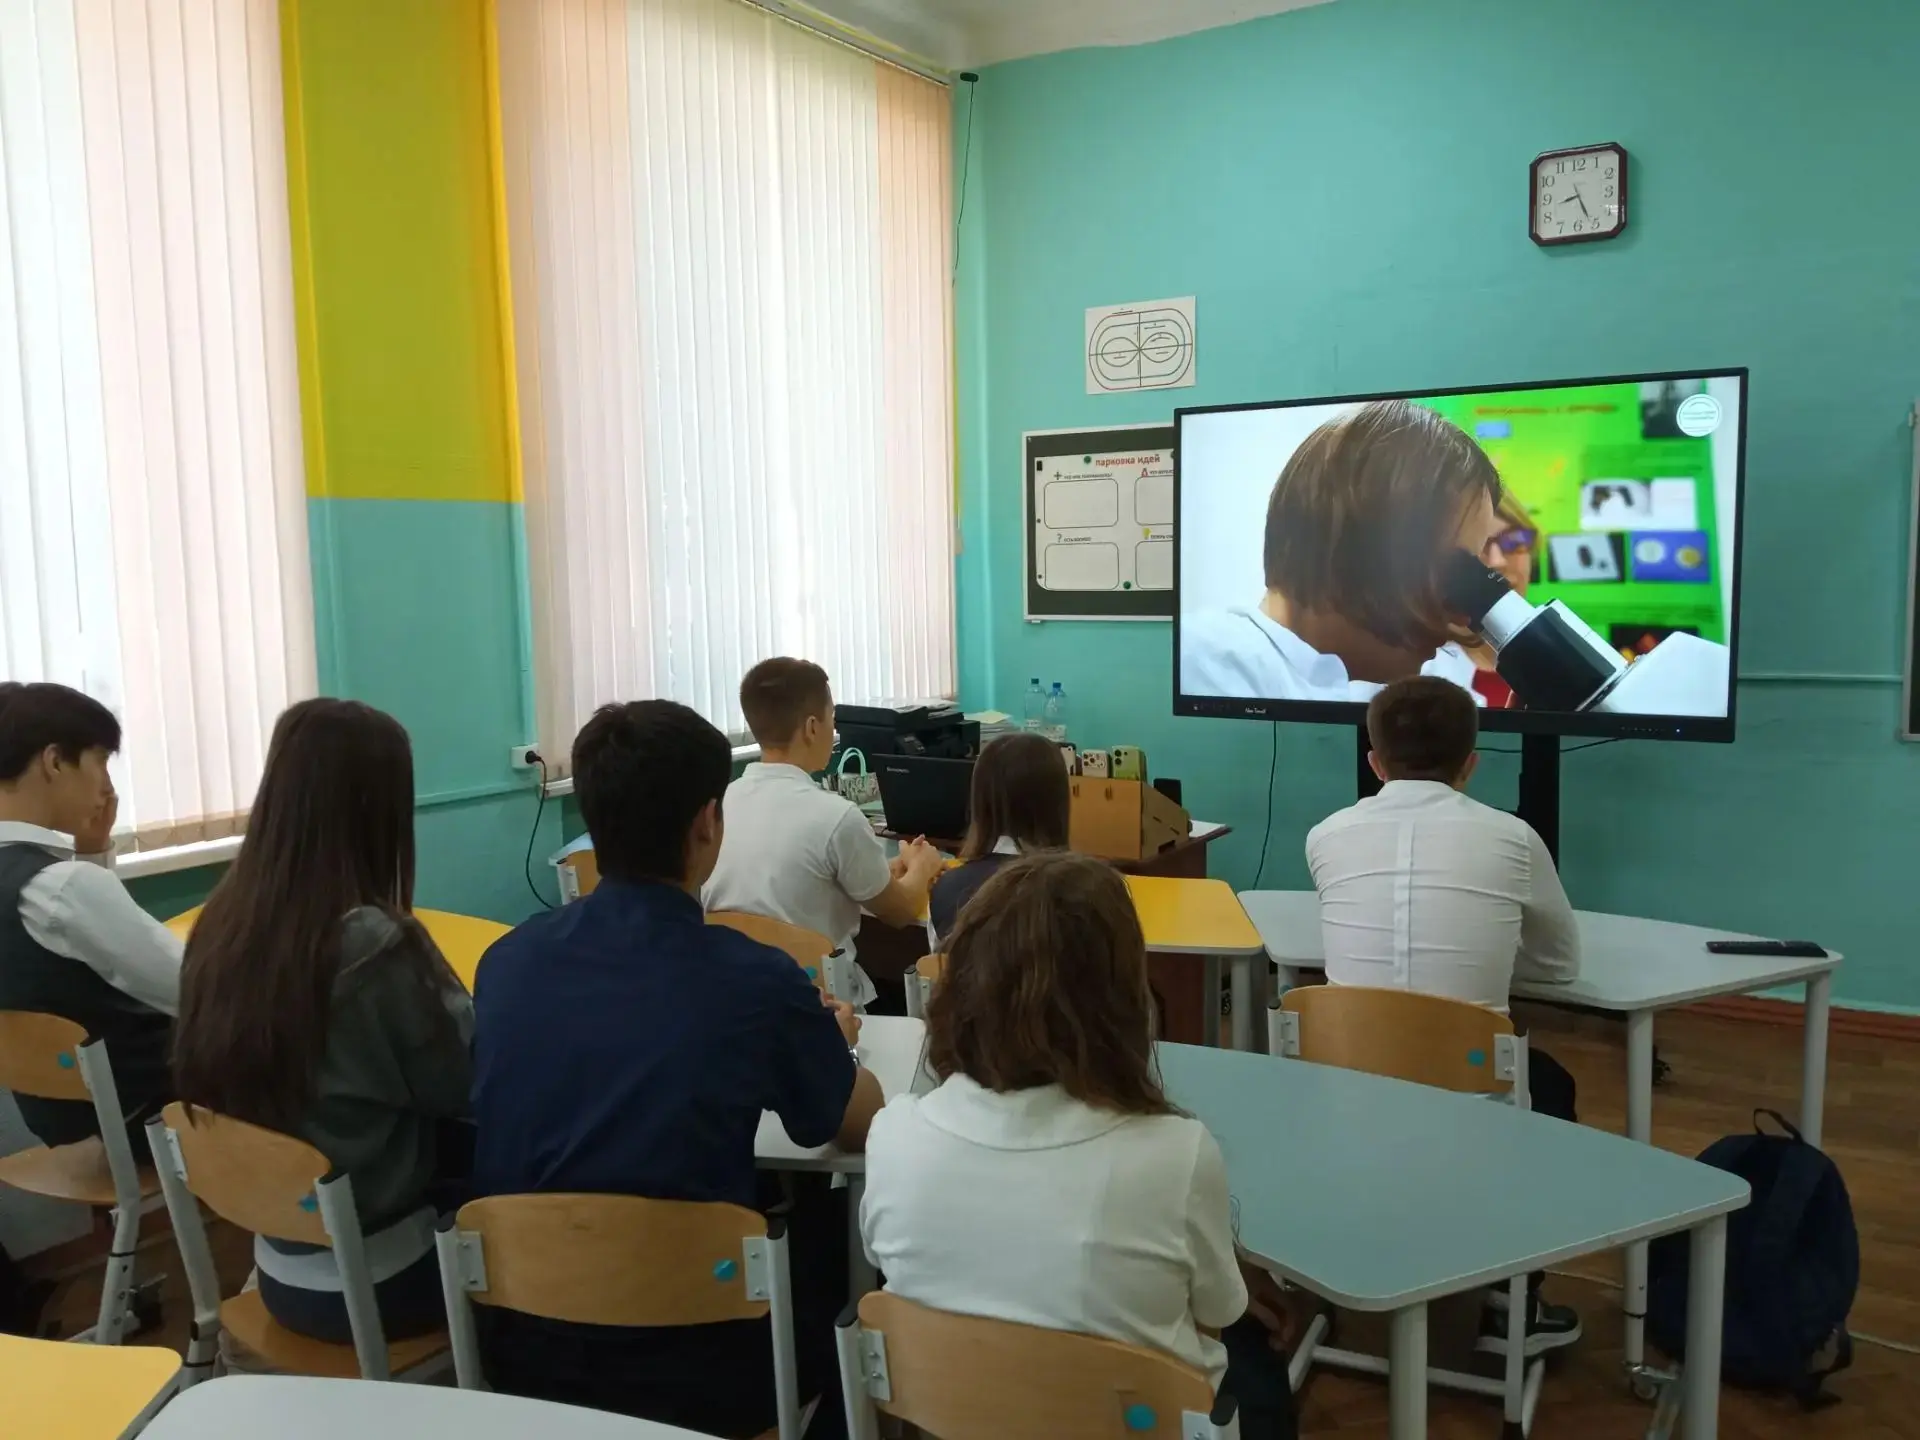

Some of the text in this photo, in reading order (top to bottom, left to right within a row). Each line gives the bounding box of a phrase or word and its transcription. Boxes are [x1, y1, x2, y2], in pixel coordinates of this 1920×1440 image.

[1556, 161, 1565, 174] 11
[1572, 158, 1587, 172] 12
[1594, 156, 1599, 169] 1
[1604, 167, 1614, 180] 2
[1541, 175, 1556, 188] 10
[1604, 185, 1614, 198] 3
[1542, 193, 1552, 206] 9
[1543, 211, 1552, 224] 8
[1591, 217, 1600, 230] 5
[1556, 221, 1565, 234] 7
[1573, 219, 1583, 232] 6
[1095, 453, 1161, 468] парковка идей
